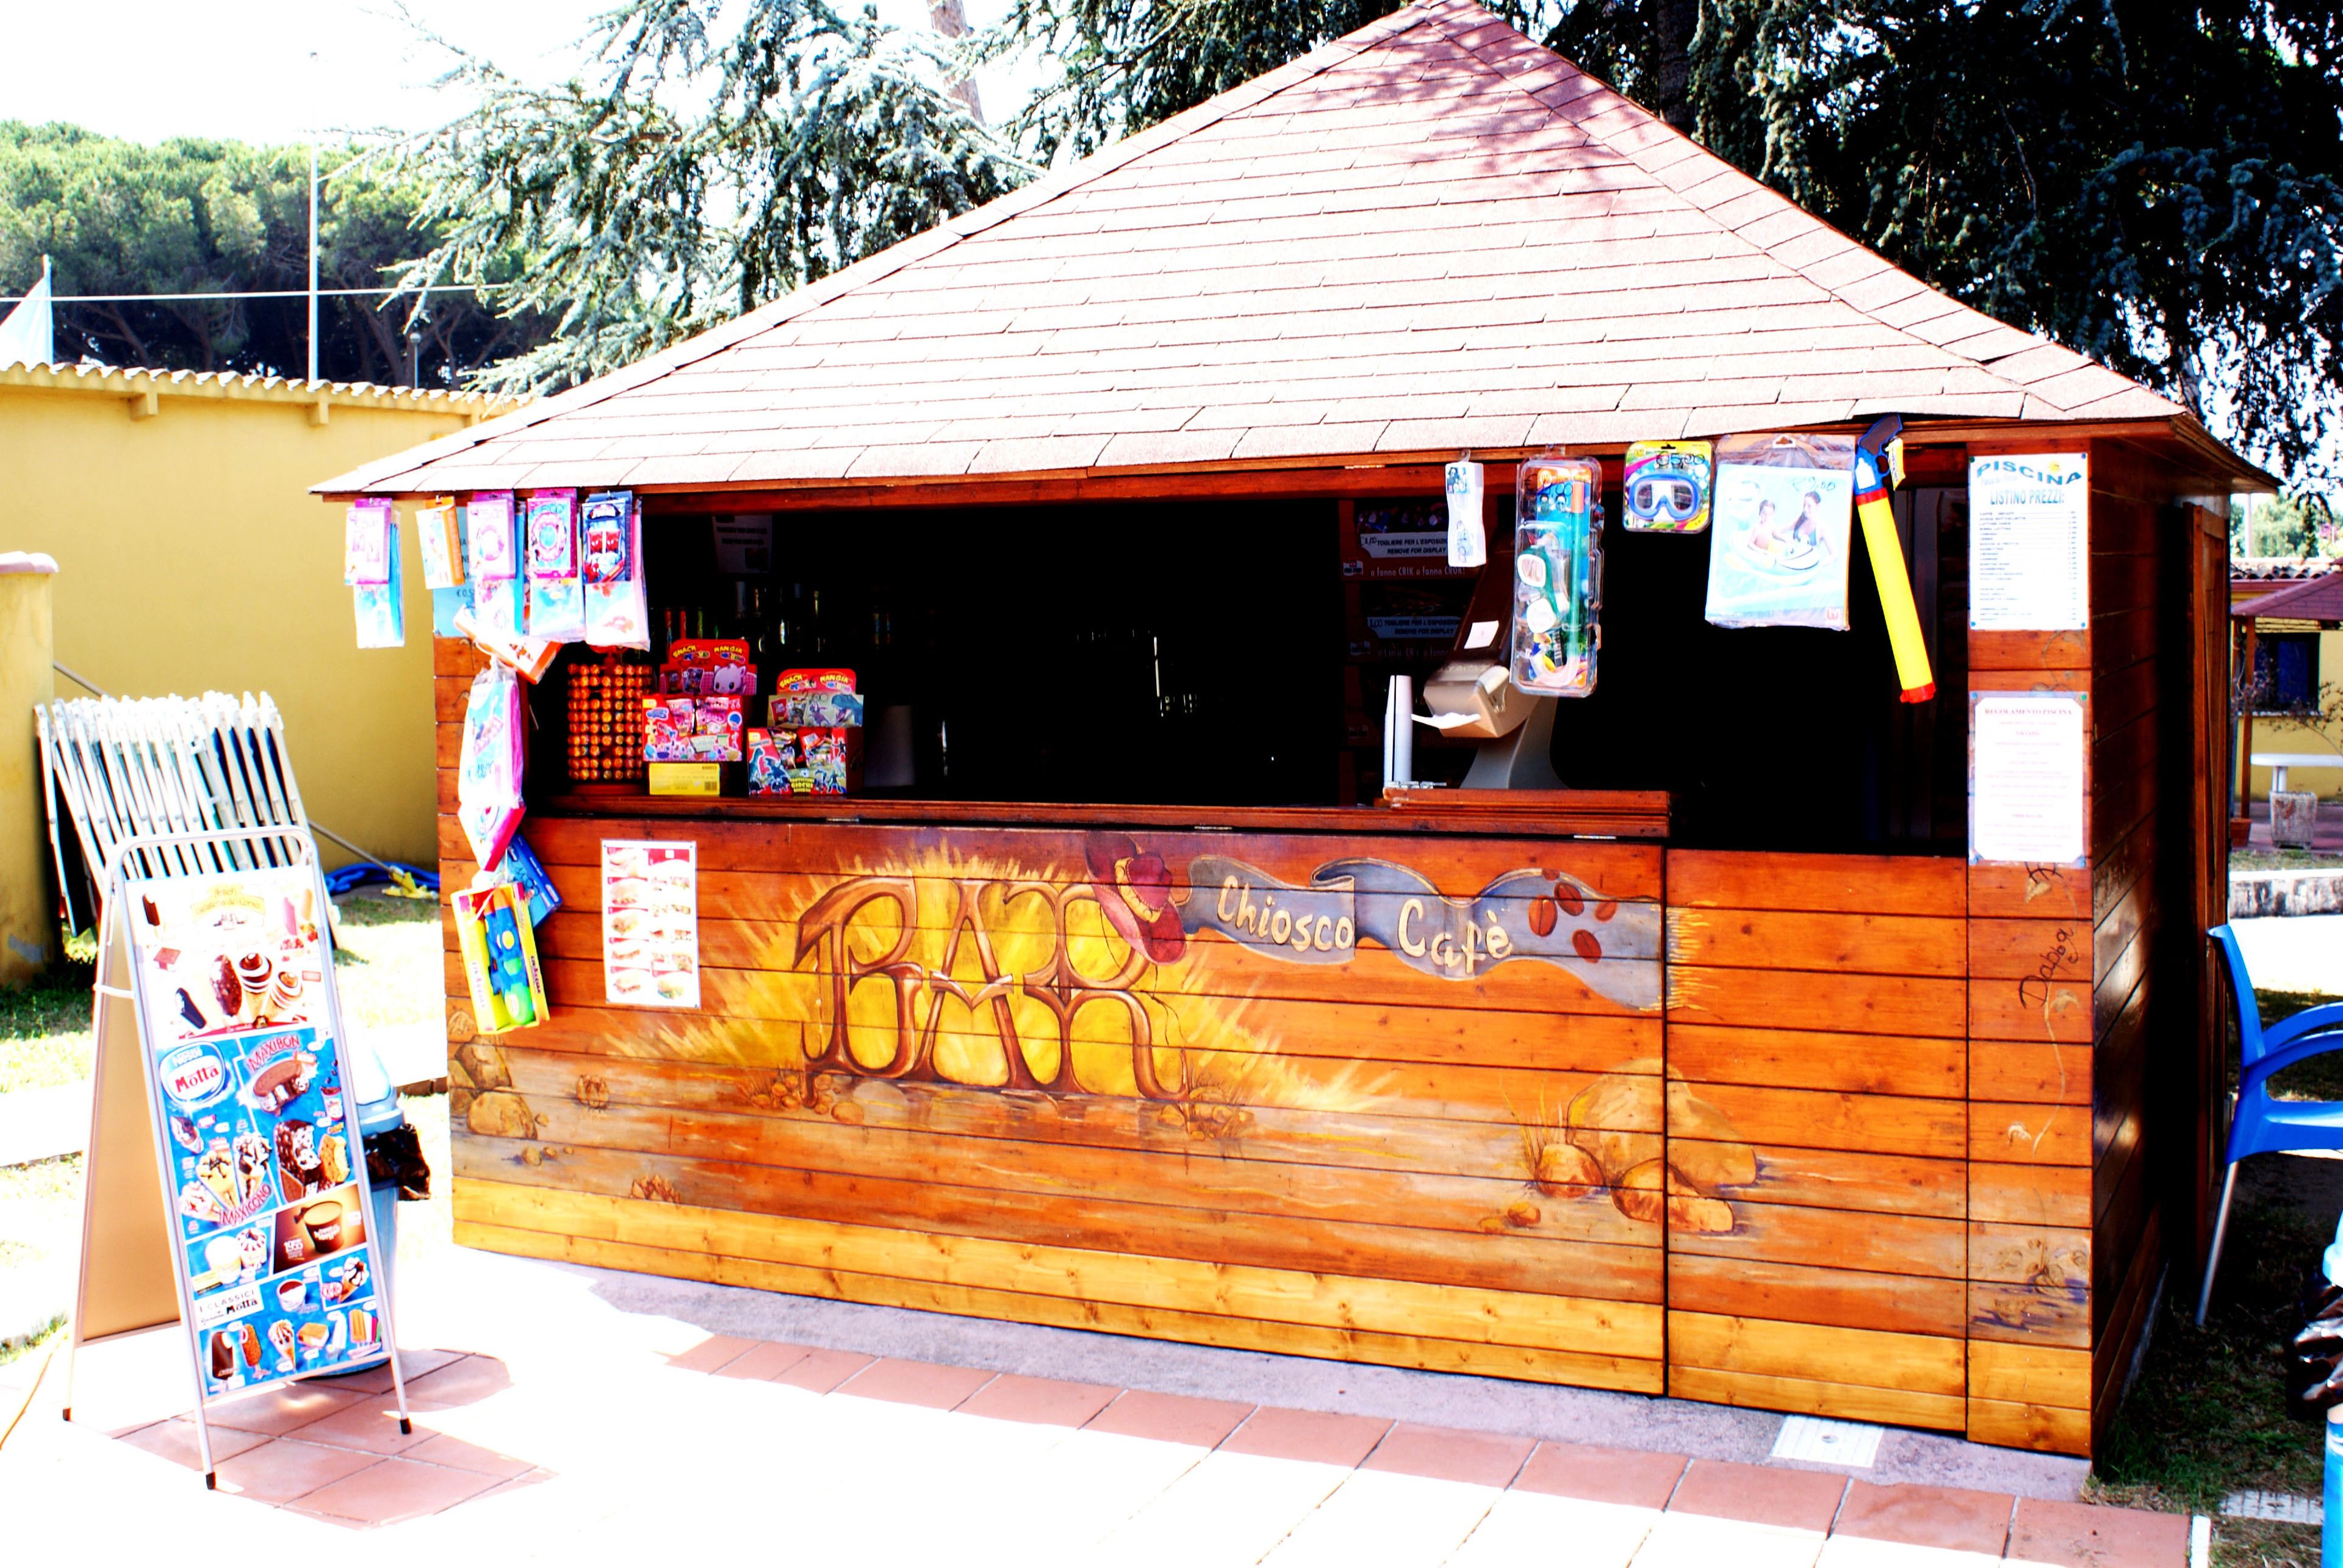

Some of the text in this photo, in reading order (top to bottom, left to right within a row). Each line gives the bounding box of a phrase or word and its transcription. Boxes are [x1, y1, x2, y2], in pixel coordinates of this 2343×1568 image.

[1977, 461, 2082, 486] PISCINA
[1990, 489, 2065, 505] LISTINO PREZZI:
[1377, 566, 1397, 577] fanno
[1398, 566, 1414, 577] CRIK
[1422, 566, 1442, 576] fanno
[1217, 876, 1513, 974] Chiosco Cafè
[793, 876, 1189, 1108] BAR
[247, 1034, 300, 1072] MAXIBON
[175, 1065, 220, 1093] Motta
[218, 1184, 272, 1226] MAXICONO
[207, 1291, 254, 1309] CLASSICI
[226, 1298, 258, 1315] Motta
